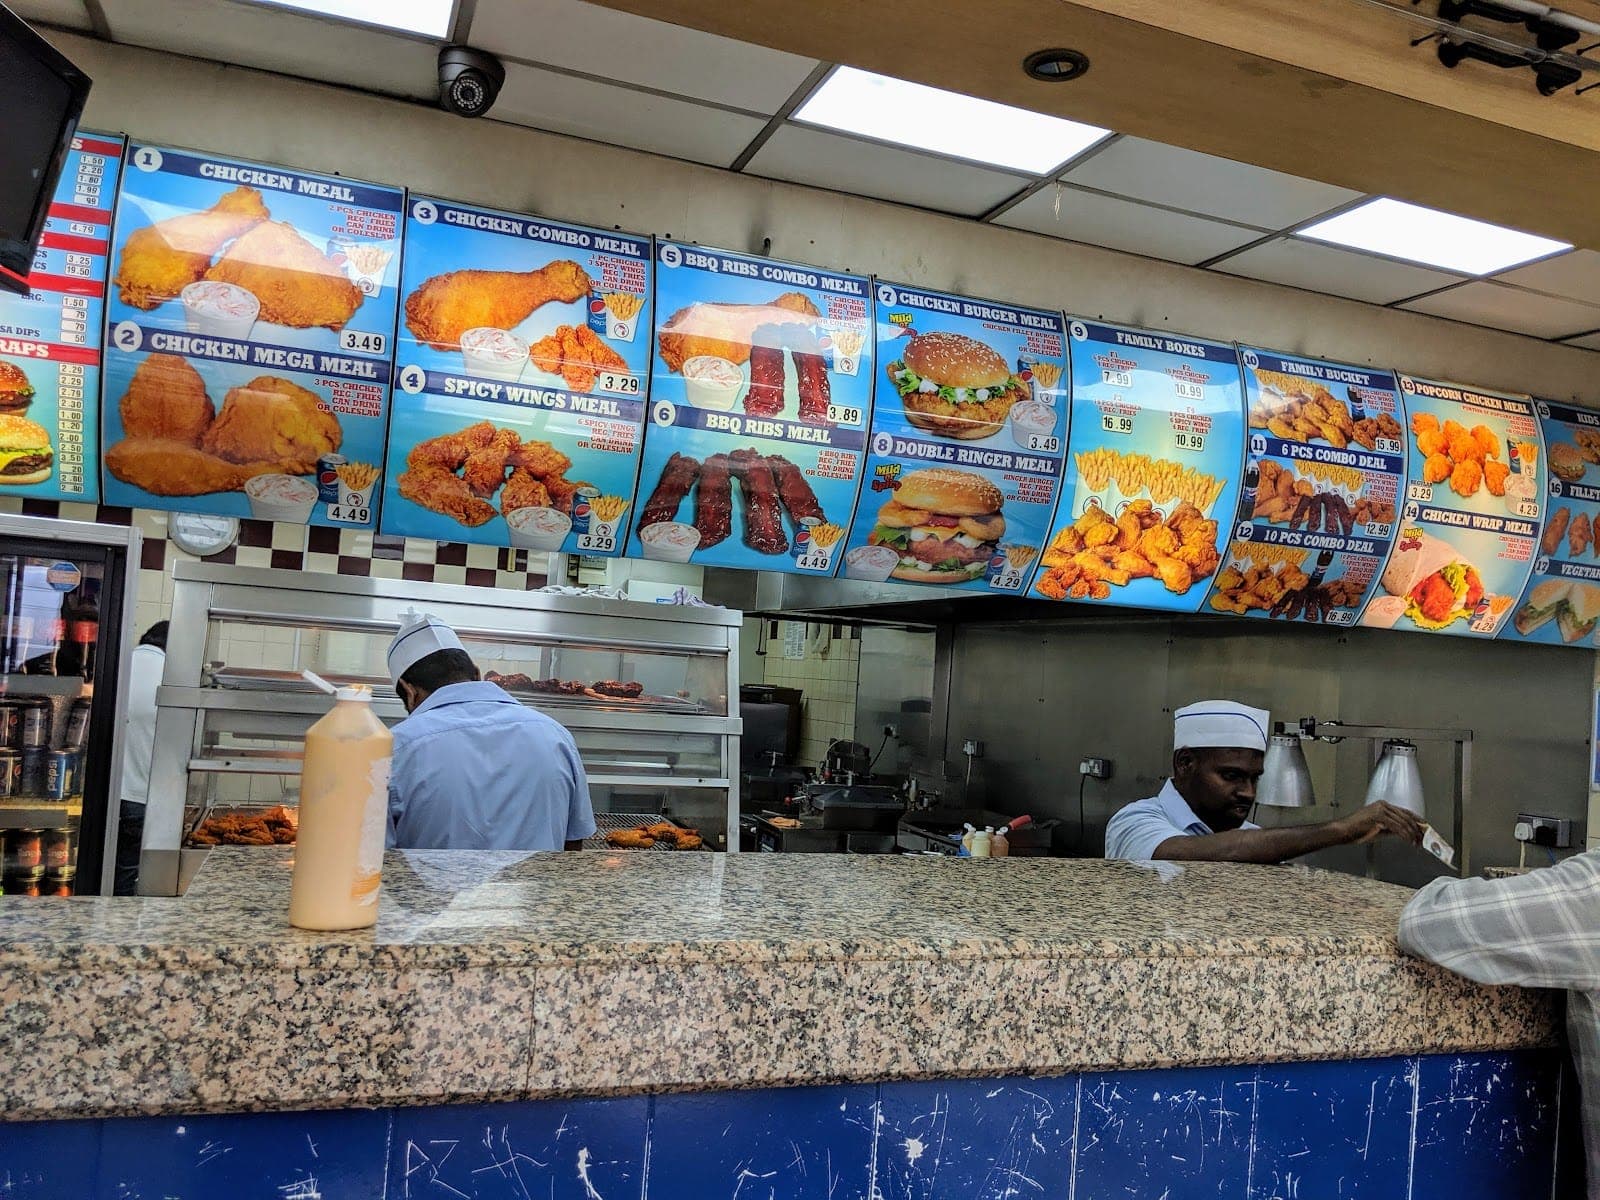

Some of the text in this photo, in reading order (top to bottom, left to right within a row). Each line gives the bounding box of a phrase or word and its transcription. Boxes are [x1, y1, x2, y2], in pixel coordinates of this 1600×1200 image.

[143, 152, 152, 166] 1
[200, 163, 354, 202] CHICKEN MEAL
[336, 206, 396, 220] PCS CHICKEN
[419, 207, 431, 220] 3
[71, 224, 94, 234] 4.79
[346, 221, 395, 234] CAN DRINK
[370, 218, 395, 227] FRIES
[347, 228, 395, 240] COLESLAW
[444, 210, 641, 256] CHICKEN COMBO MEAL
[68, 255, 90, 265] 3.25
[610, 257, 646, 268] CHICKEN
[666, 250, 677, 262] 5
[67, 266, 90, 276] 19.50
[595, 260, 646, 275] SPICY WINGS
[686, 252, 862, 295] BBQ RIBS COMBO MEAL
[602, 275, 646, 288] CAN DRINK
[622, 271, 646, 281] FRIES
[603, 282, 646, 294] COLESLAW
[882, 291, 892, 302] 7
[900, 292, 1057, 330] CHICKEN BURGER MEAL
[889, 313, 913, 323] Mild
[16, 327, 41, 338] DIPS
[120, 329, 135, 346] 2
[1074, 326, 1083, 336] 9
[347, 333, 382, 351] 3.49
[1116, 332, 1205, 358] FAMILY BOXES
[151, 333, 377, 378] CHICKEN MEGA MEAL
[1244, 354, 1257, 366] 10
[61, 364, 82, 374] 2.29
[1280, 360, 1370, 386] FAMILY BUCKET
[61, 376, 82, 386] 2.29
[406, 373, 418, 388] 4
[605, 376, 638, 392] 3.29
[1104, 371, 1129, 385] 7.99
[342, 382, 383, 394] CHICKEN
[1176, 384, 1202, 397] 10.99
[332, 397, 382, 409] CAN DRINK
[356, 392, 382, 402] FRIES
[444, 378, 621, 416] SPICY WINGS MEAL
[1416, 383, 1462, 401] POPCORN
[1462, 392, 1503, 410] CHICKEN
[1503, 400, 1530, 414] MEAL
[61, 411, 82, 420] 1.00
[317, 403, 380, 418] OR COLESLAW
[658, 408, 670, 421] 6
[829, 406, 858, 422] 3.89
[1539, 405, 1550, 416] 15
[584, 419, 636, 432] SPICY WINGS
[1104, 416, 1132, 431] 16.99
[1576, 412, 1600, 426] KIDS
[61, 422, 80, 430] 1.20
[706, 413, 832, 444] BBQ RIBS MEAL
[612, 431, 635, 440] FRIES
[1176, 434, 1203, 448] 10.99
[591, 443, 634, 454] COLESLAW
[878, 438, 887, 451] 8
[1031, 437, 1057, 450] 3.49
[1253, 439, 1264, 451] 11
[1376, 440, 1400, 452] 15.99
[895, 440, 1054, 474] DOUBLE RINGER MEAL
[1282, 444, 1387, 470] 6 PCS COMBO DEAL
[818, 470, 853, 480] COLESLAW
[876, 465, 900, 476] Mild
[1412, 487, 1431, 499] 3.29
[1551, 482, 1561, 494] 16
[332, 506, 368, 521] 4.49
[1406, 506, 1417, 518] 14
[1520, 504, 1538, 516] 4.29
[1422, 508, 1534, 535] CHICKEN WRAP MEAL
[1238, 526, 1251, 538] 12
[1366, 523, 1389, 536] 12.99
[1404, 528, 1424, 538] Mild
[583, 536, 612, 549] 3.29
[1263, 529, 1375, 553] 10 PCS COMBO DEAL
[800, 556, 828, 569] 4.49
[1536, 560, 1548, 572] 17
[993, 576, 1020, 588] 4.29
[1328, 611, 1354, 622] 16.99
[48, 760, 59, 792] pepsi
